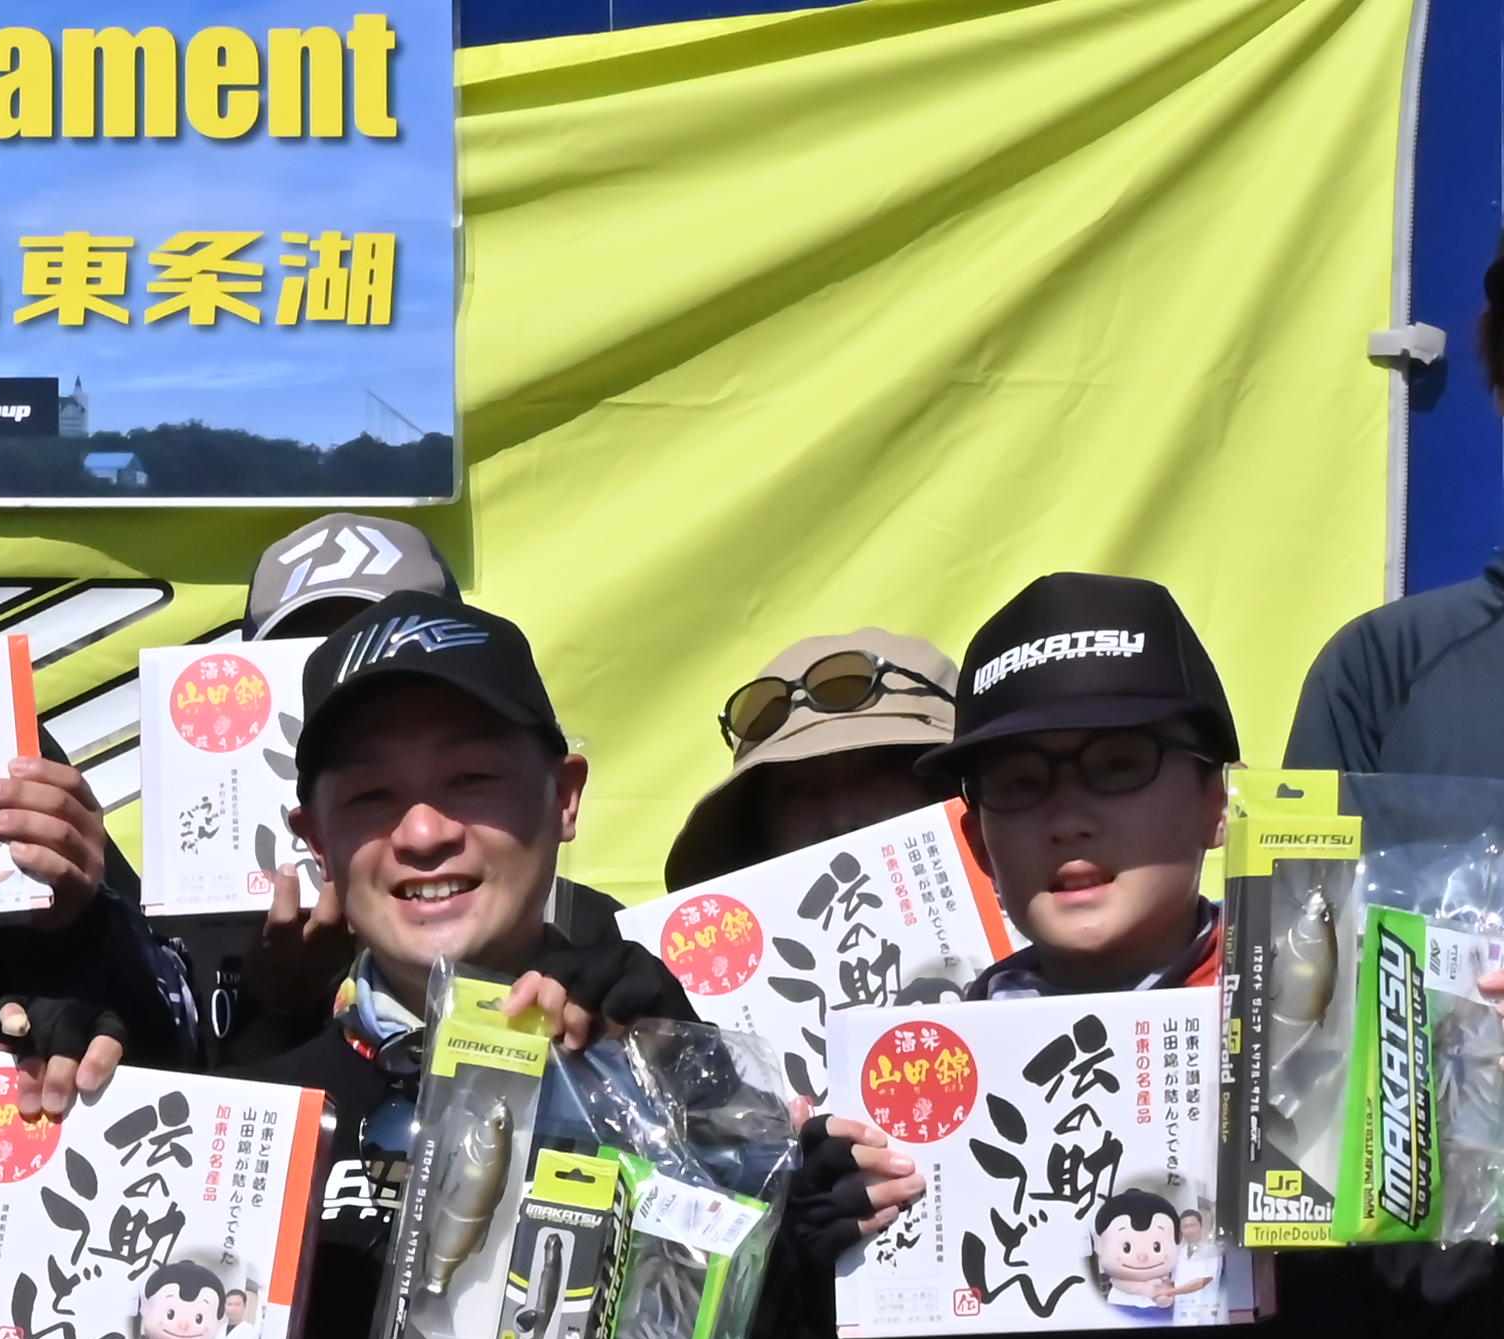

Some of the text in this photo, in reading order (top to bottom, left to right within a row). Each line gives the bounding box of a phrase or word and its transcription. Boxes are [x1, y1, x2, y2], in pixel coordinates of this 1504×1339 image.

[14, 231, 395, 326] 東条湖
[973, 630, 1145, 696] IMAKATSU
[1259, 833, 1354, 847] IMAKATSU
[447, 1036, 539, 1064] IMAKATSU
[1380, 943, 1414, 1222] IMAKATSU
[526, 1204, 603, 1227] IMAKATSU
